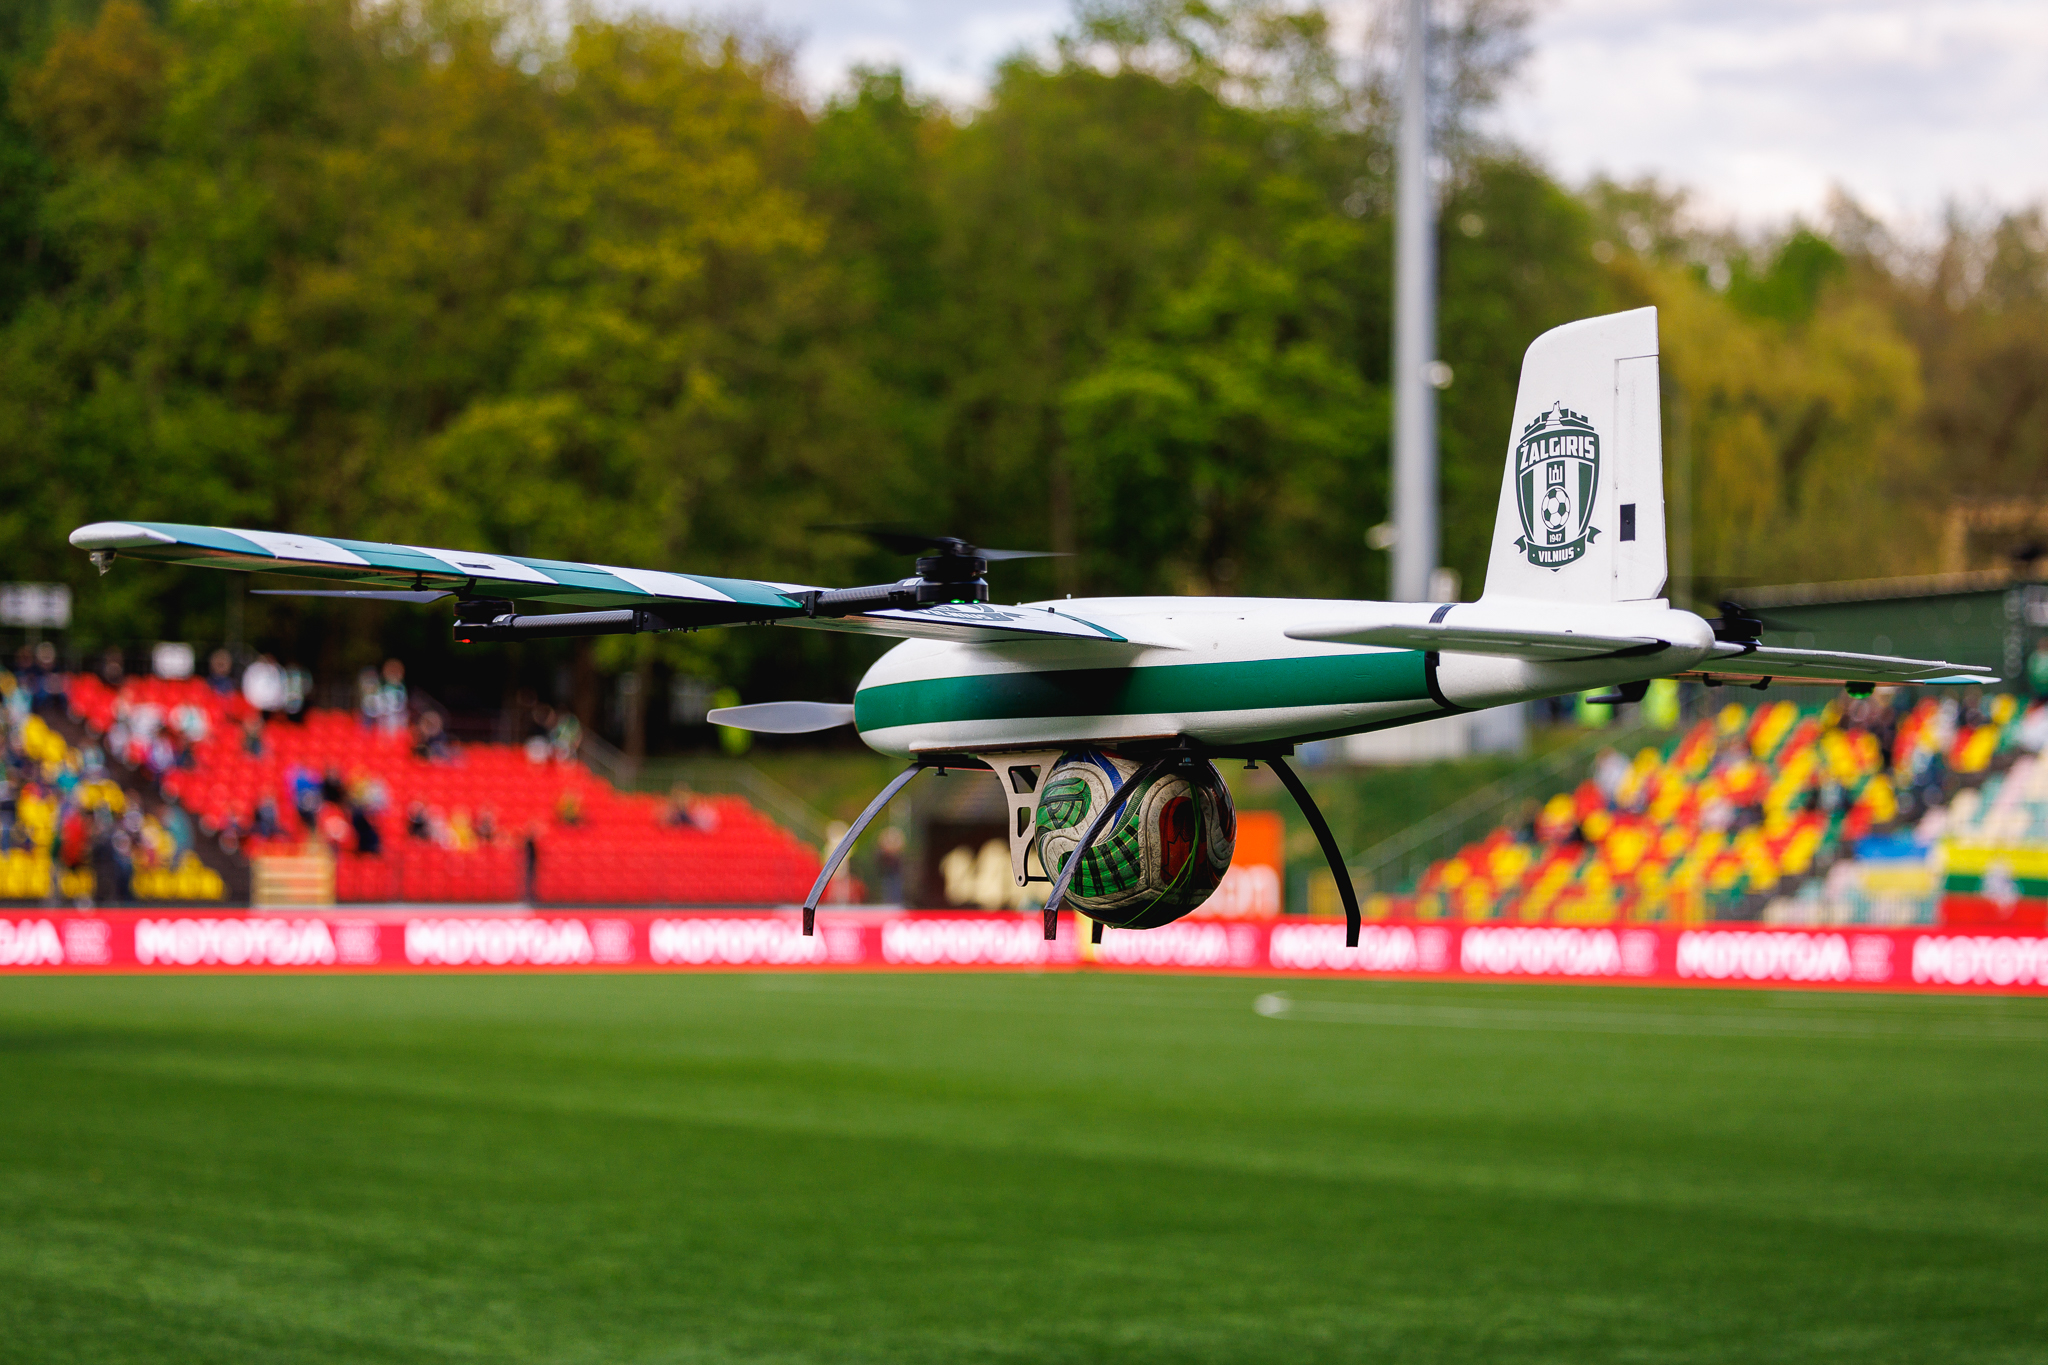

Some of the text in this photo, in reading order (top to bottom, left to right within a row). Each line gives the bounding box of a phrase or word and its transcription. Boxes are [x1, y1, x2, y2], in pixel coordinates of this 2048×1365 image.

[1519, 435, 1595, 471] ŽALGIRIS
[1549, 533, 1562, 543] 1947
[1537, 547, 1575, 563] VILNIUS
